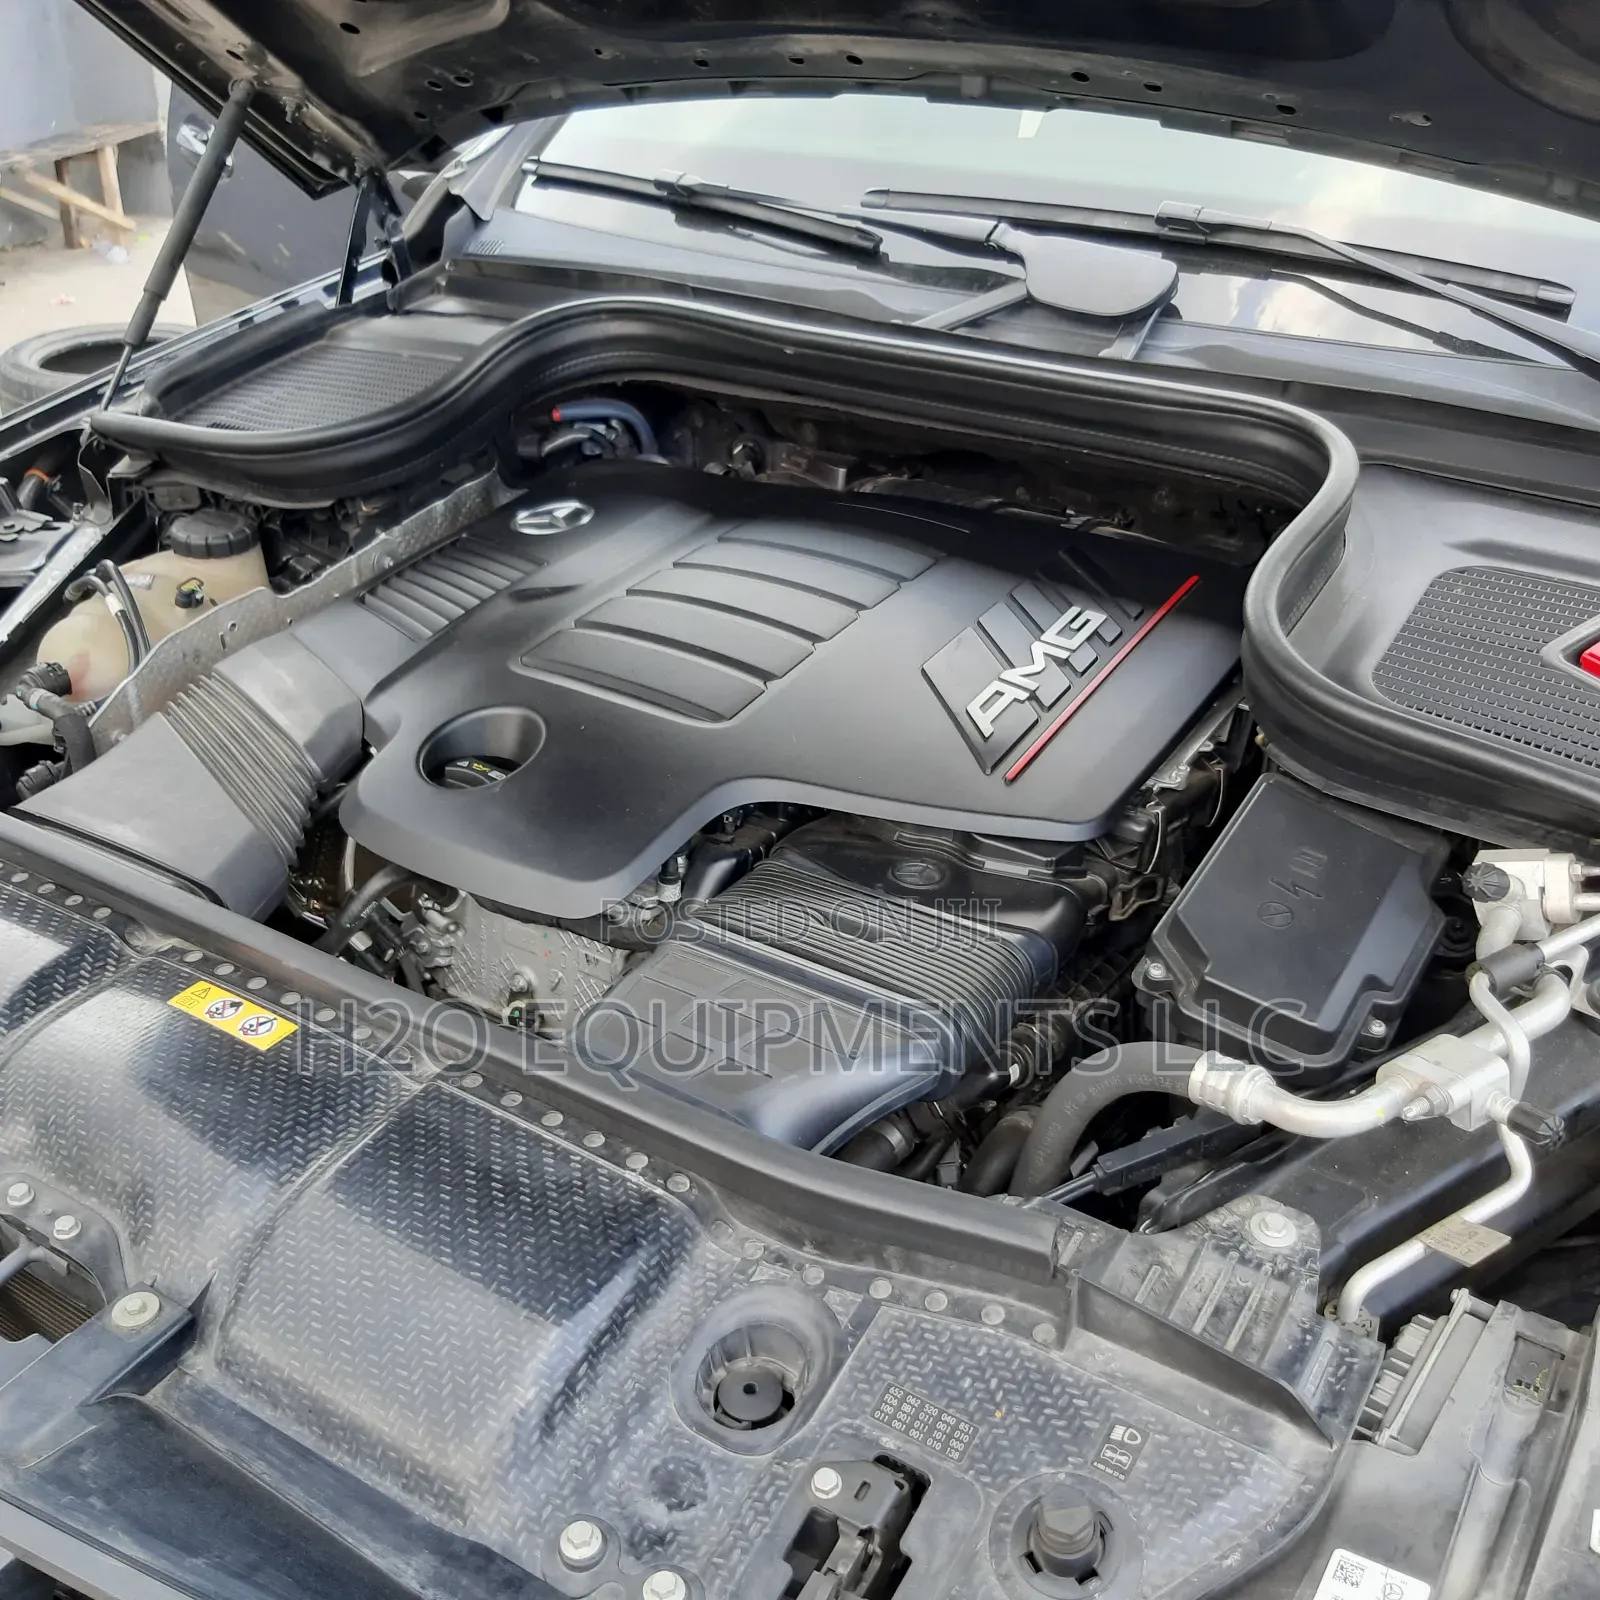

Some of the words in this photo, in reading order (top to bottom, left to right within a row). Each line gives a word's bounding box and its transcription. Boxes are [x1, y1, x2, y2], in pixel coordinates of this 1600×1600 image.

[966, 606, 1107, 739] AMG
[874, 1410, 889, 1421] 011
[891, 1420, 906, 1431] 001
[908, 1429, 923, 1440] 001
[926, 1438, 942, 1450] 010
[880, 1403, 894, 1414] 100
[896, 1411, 911, 1423] 001
[913, 1421, 928, 1432] 011
[932, 1430, 946, 1441] 101
[949, 1439, 965, 1450] 000
[888, 1387, 903, 1398] 652
[906, 1395, 921, 1407] 062
[924, 1404, 938, 1415] 520
[941, 1413, 956, 1424] 040
[959, 1422, 974, 1434] 851
[919, 1412, 933, 1423] 011
[936, 1421, 951, 1432] 001
[954, 1430, 969, 1442] 010
